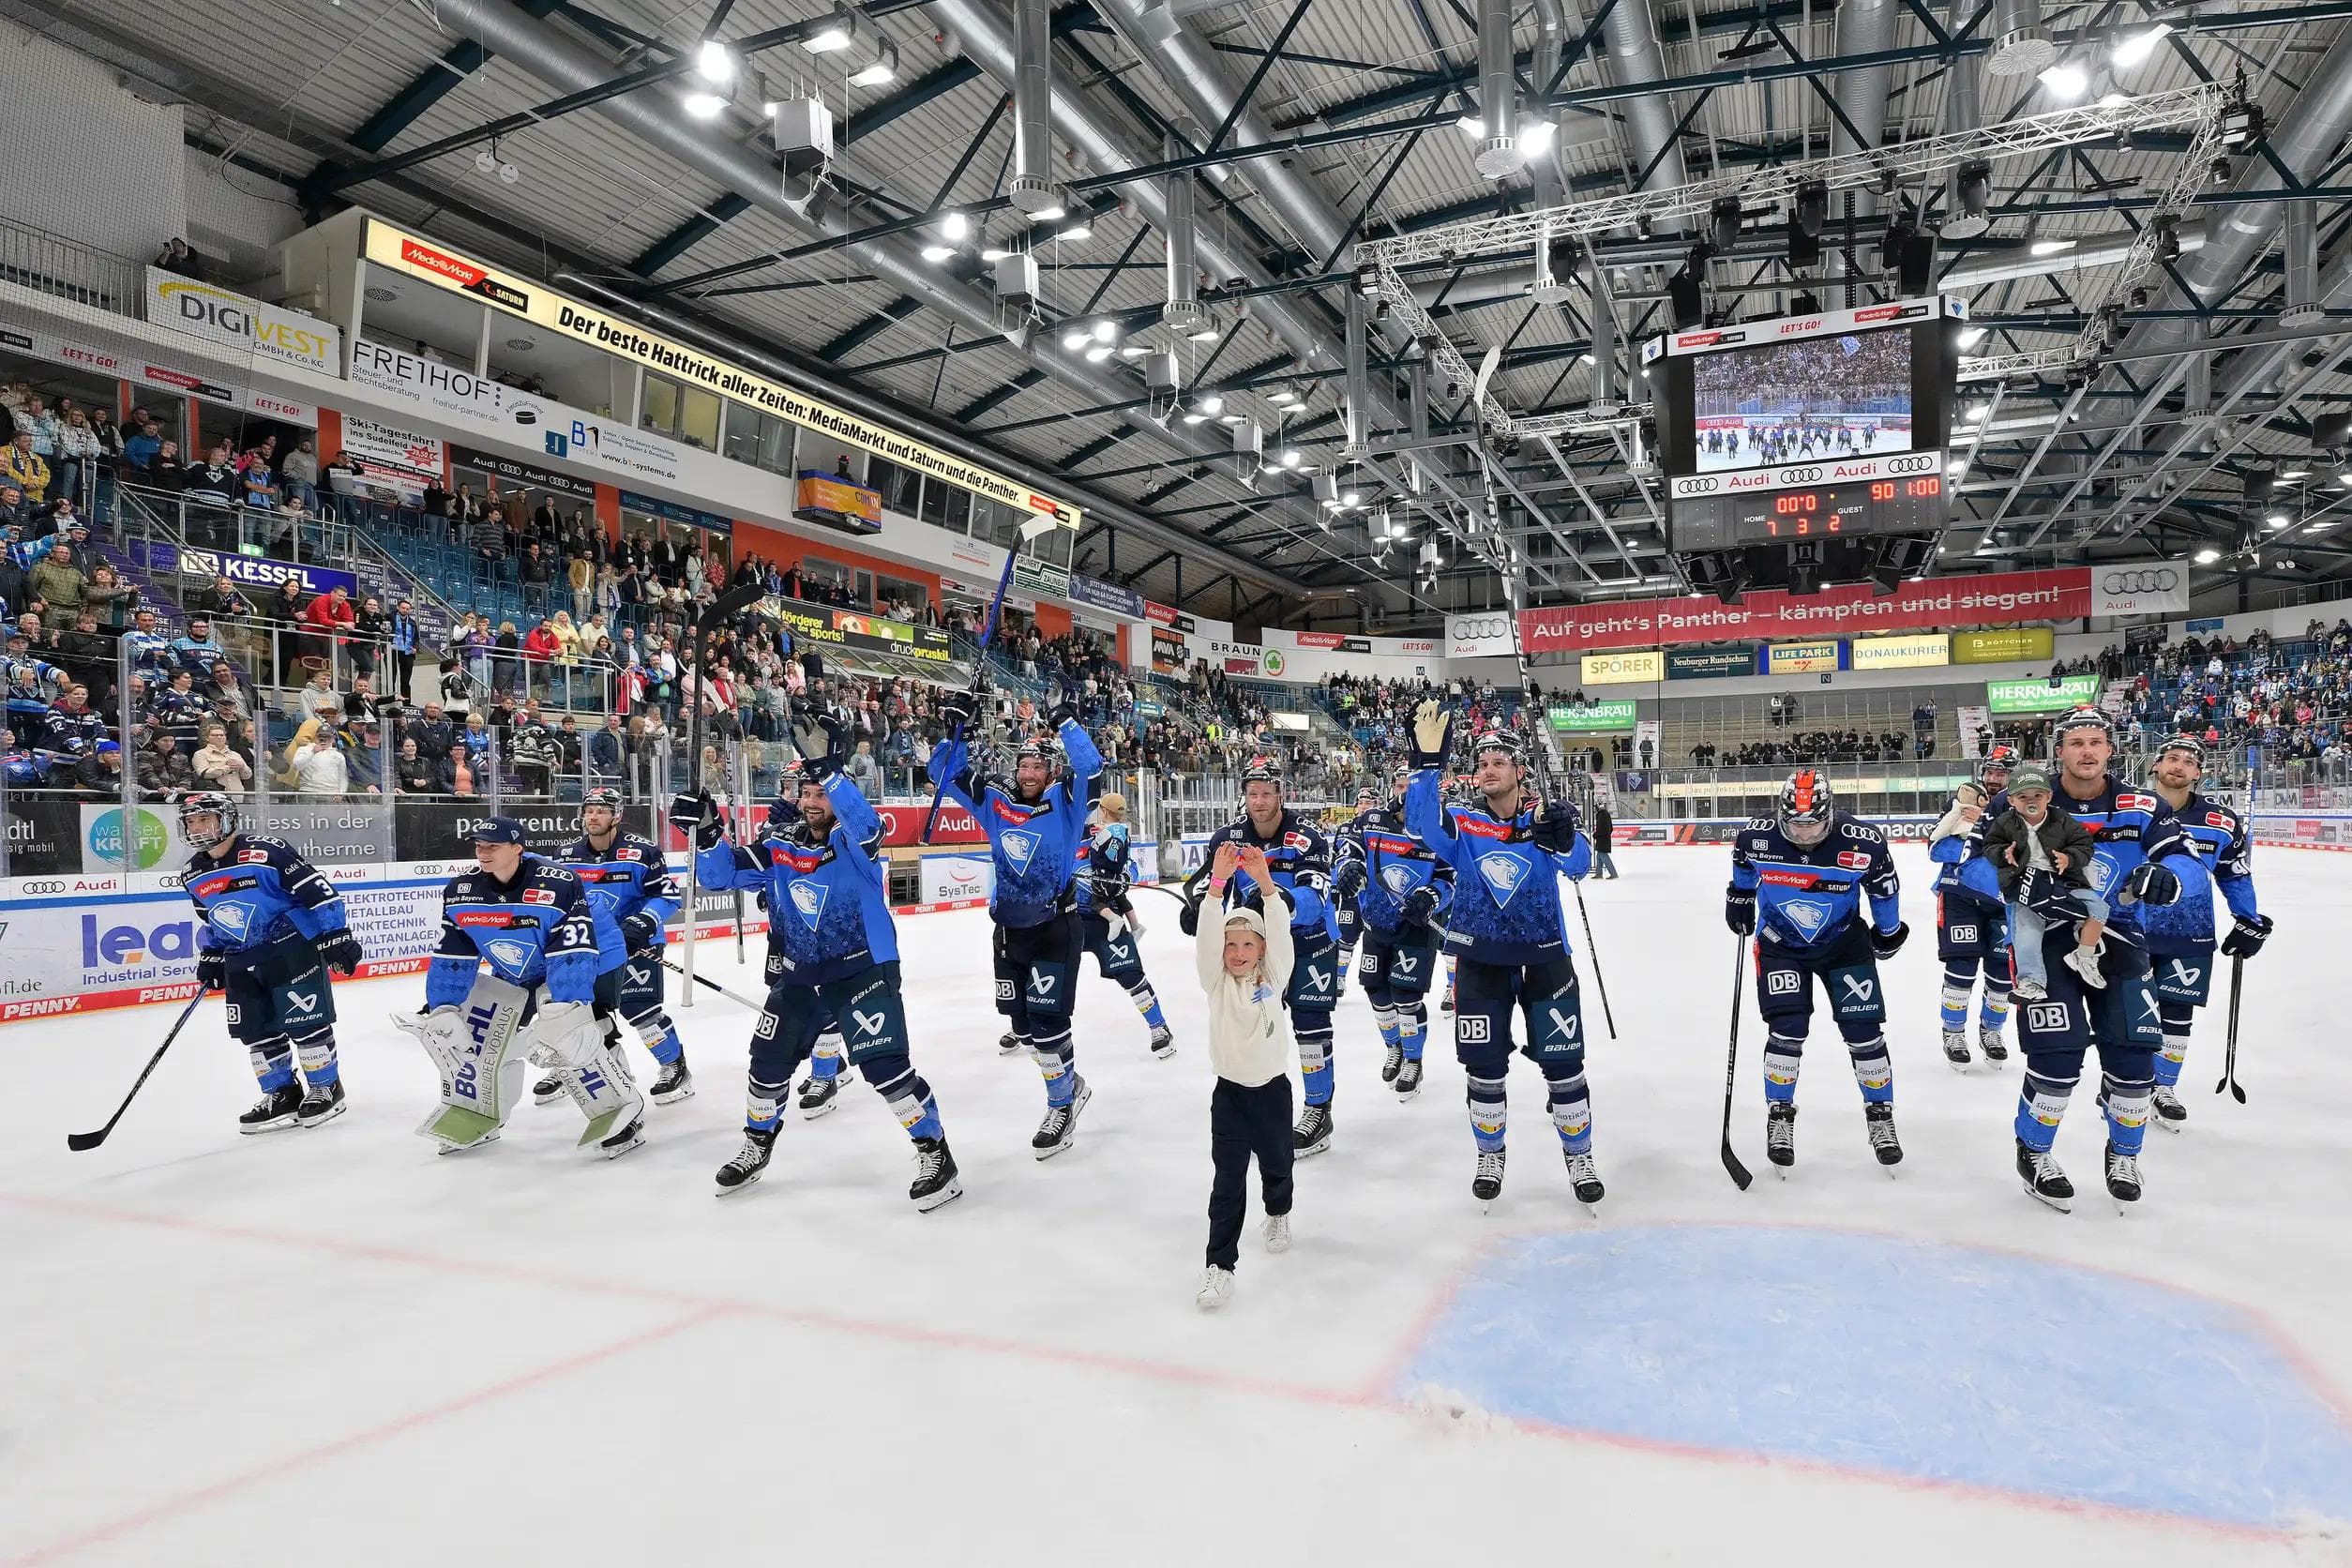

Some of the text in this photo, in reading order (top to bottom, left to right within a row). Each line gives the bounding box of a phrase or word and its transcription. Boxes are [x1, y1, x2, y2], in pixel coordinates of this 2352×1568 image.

[496, 288, 524, 307] SATURN
[1781, 320, 1821, 333] LET'S GO!
[254, 340, 285, 357] GMBH
[286, 351, 294, 359] &
[63, 347, 117, 369] LET'S GO!
[353, 365, 403, 386] Steuer- und
[353, 374, 420, 400] Rechtsberatung
[255, 398, 300, 416] LET'S GO!
[432, 398, 499, 423] freihof-partner.de
[558, 306, 1019, 502] Der beste Hattrick aller Zeiten: MediaMarkt und Saturn und die Panther.
[350, 417, 434, 446] Ski-Tagesfahrt
[350, 429, 408, 449] ins Sudelfeld
[601, 453, 675, 479] www.b1-systems.de
[474, 457, 593, 494] Audi Audi Audi
[1729, 463, 1877, 488] Audi Audi
[1872, 484, 1893, 499] 90
[1744, 515, 1766, 523] HOME
[1799, 519, 1808, 534] 3
[1830, 516, 1840, 531] 2
[1767, 521, 1776, 535] 7
[225, 563, 315, 589] KESSEL
[1533, 620, 1574, 638] Auf
[1658, 609, 1752, 630] Panther
[1779, 598, 1892, 622] kämpfen
[1902, 593, 1952, 612] und
[1960, 586, 2058, 611] siegen!
[2105, 599, 2137, 611] Audi
[781, 611, 823, 629] förderer
[810, 627, 844, 642] sports!
[1212, 642, 1260, 656] BRAUN
[1403, 642, 1433, 651] LET'S GO!
[1455, 644, 1477, 654] Audi
[1775, 647, 1832, 658] LIFE PARK
[1856, 644, 1947, 658] DONAUKURIER
[1674, 655, 1749, 667] Neuburger Rundschau
[310, 810, 373, 829] in der
[939, 815, 975, 832] Audi
[27, 842, 54, 852] mobil
[1754, 840, 1766, 849] DB
[284, 863, 299, 875] Café
[333, 869, 366, 879] Audi
[73, 879, 117, 891] Audi
[939, 884, 981, 898] SysTec
[347, 917, 427, 932] UNKTECHNIK
[1339, 912, 1351, 922] DB
[563, 924, 591, 945] 32
[1954, 927, 1975, 940] DB
[1109, 959, 1135, 969] BAUER
[1363, 957, 1375, 970] DB
[83, 967, 157, 986] Industrial
[291, 964, 320, 985] BAUER
[1391, 972, 1417, 982] BAUER
[1772, 973, 1798, 991] DB
[851, 980, 885, 1004] BAUER
[2159, 985, 2201, 997] BAUER
[1841, 1003, 1879, 1013] BAUER
[284, 1013, 324, 1024] BAUER
[2032, 1006, 2063, 1028] DB
[488, 1005, 514, 1056] VORAUS
[1460, 1018, 1485, 1039] DB
[852, 1037, 893, 1052] BAUER
[1545, 1042, 1581, 1052] BAUER
